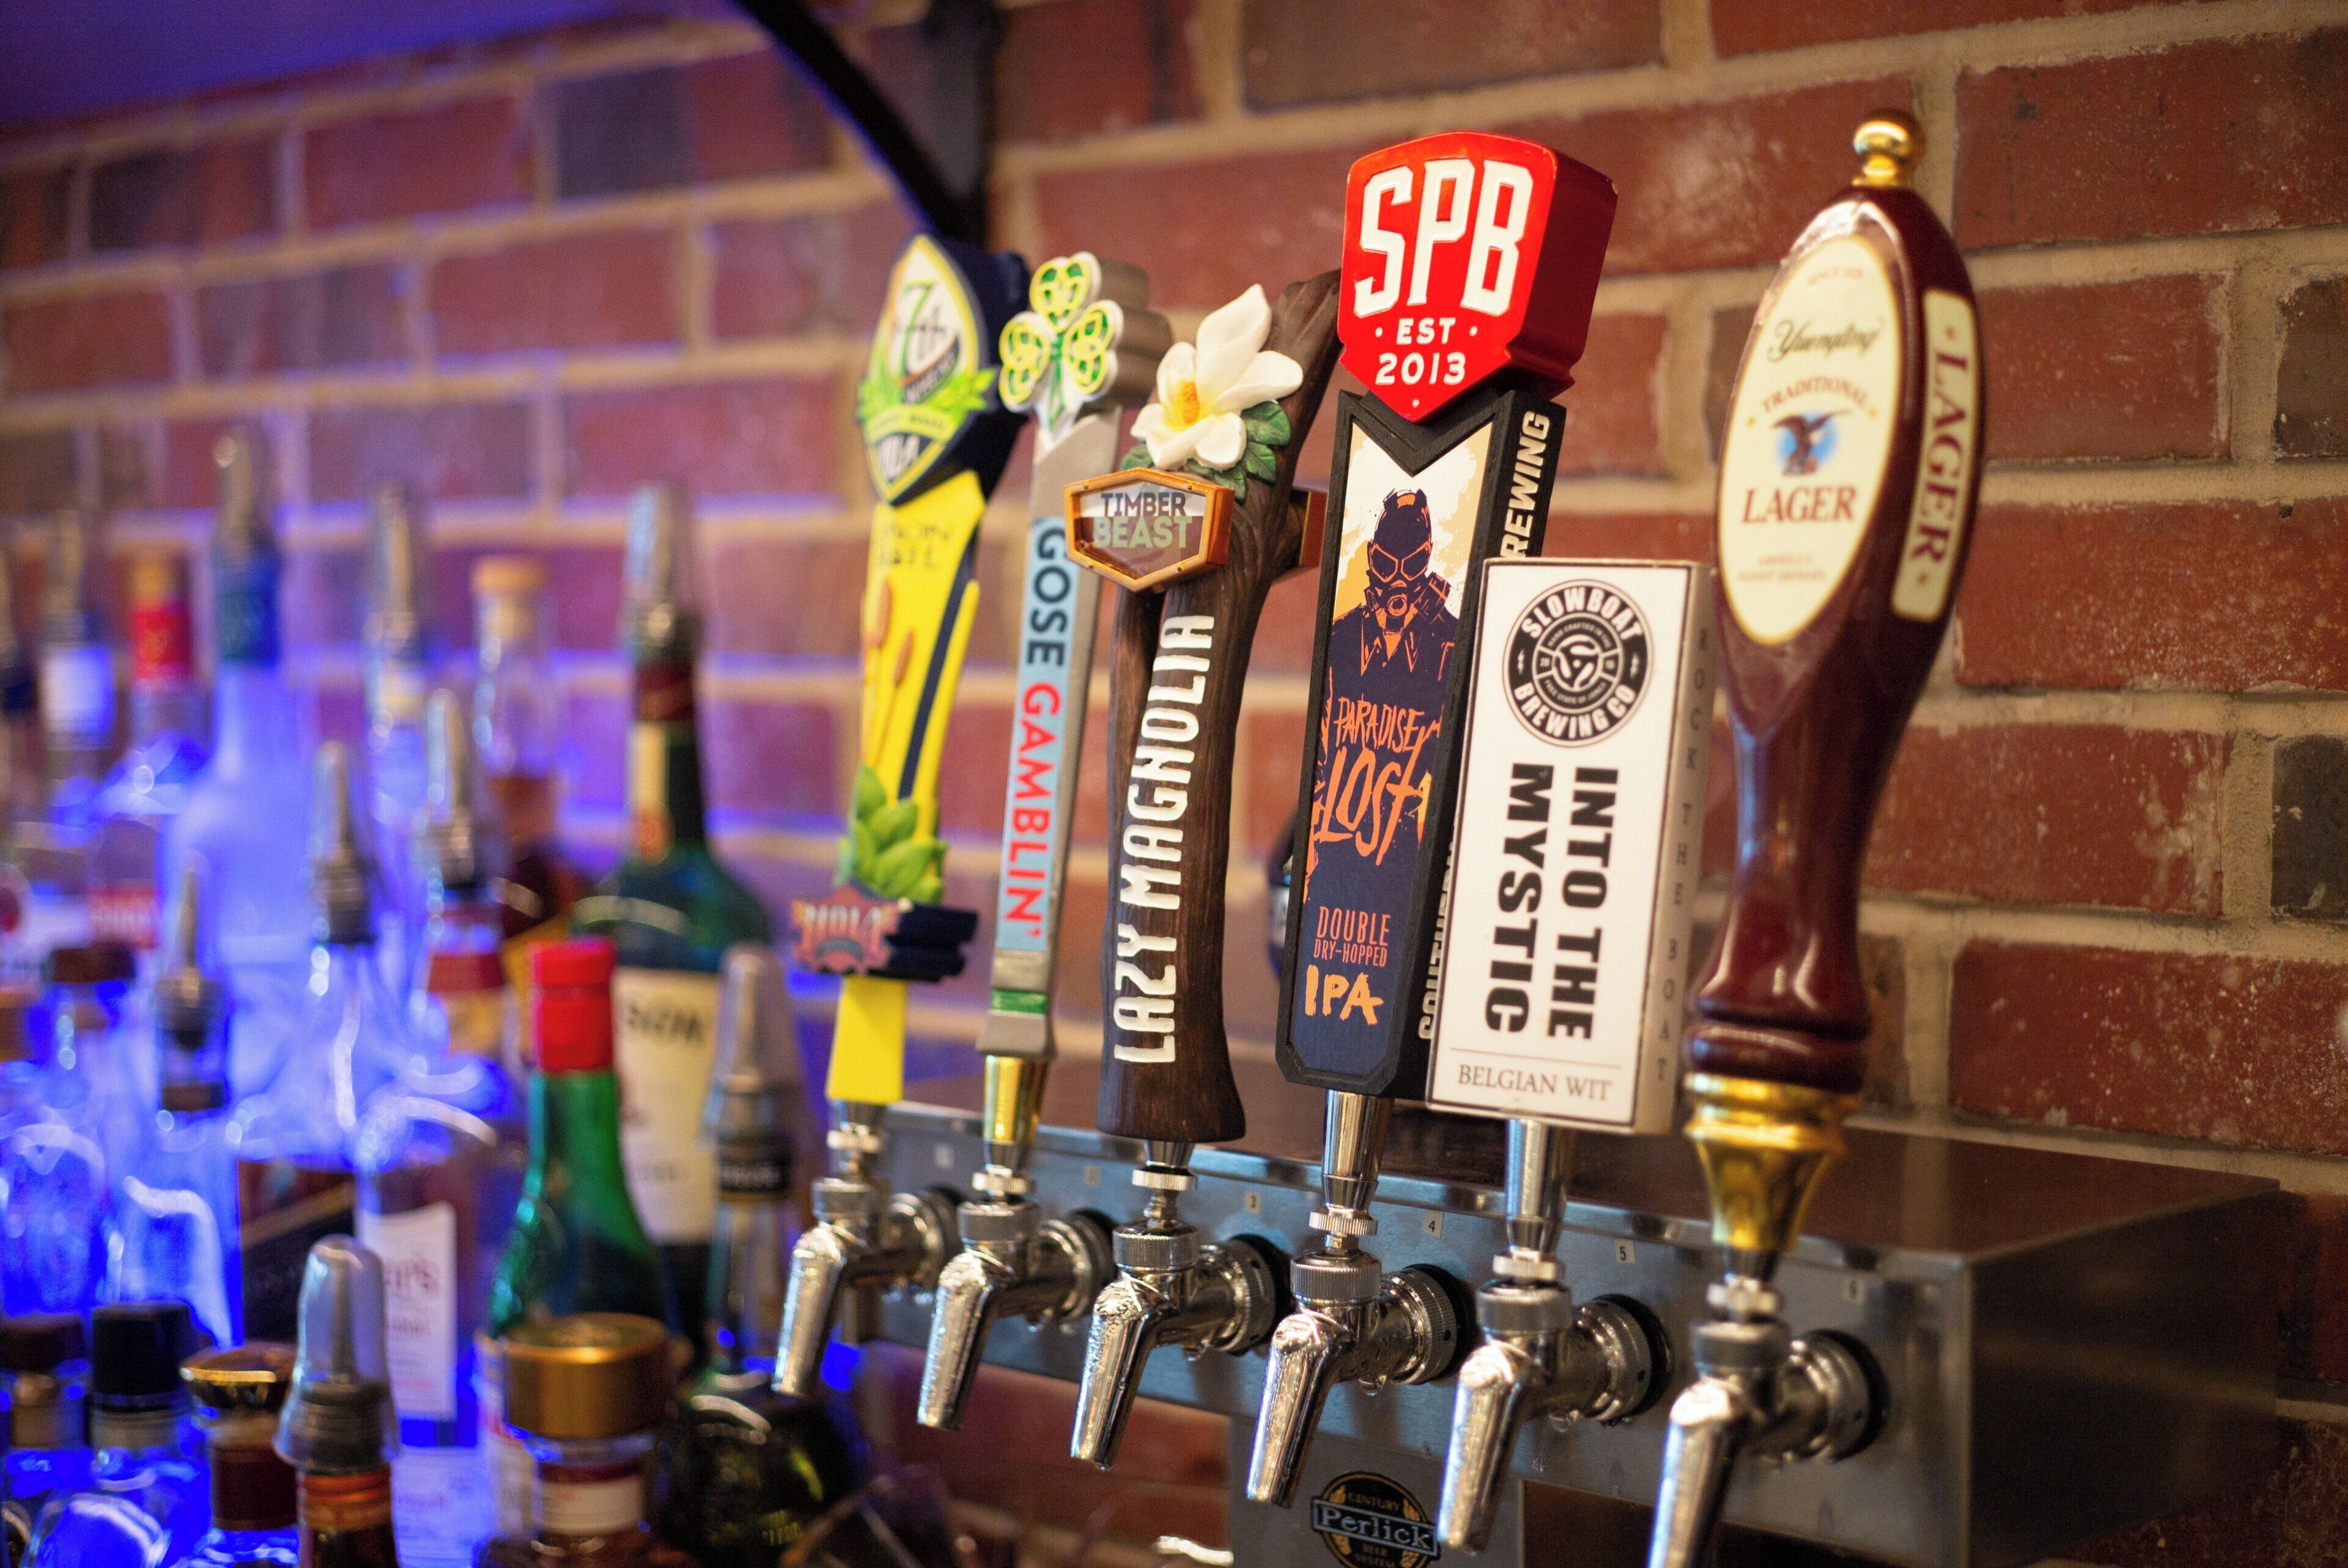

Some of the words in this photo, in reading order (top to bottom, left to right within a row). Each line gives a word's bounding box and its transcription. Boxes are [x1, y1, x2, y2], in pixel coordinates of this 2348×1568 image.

[1353, 158, 1534, 317] SPB
[1396, 317, 1456, 344] EST
[1375, 351, 1466, 385] 2013
[1762, 374, 1868, 412] TRADITIONAL
[1500, 411, 1550, 557] REWING
[1910, 350, 1968, 562] LAGER
[1093, 515, 1193, 549] BEAST
[1101, 492, 1186, 517] TIMBER
[1741, 485, 1857, 524] LAGER
[1026, 526, 1072, 668] GOSE
[1521, 586, 1643, 641] SLOWBOAT
[1333, 694, 1425, 754] PARADISE
[1513, 682, 1611, 740] BREWING
[1606, 683, 1637, 719] CO
[1120, 615, 1215, 910] MAGNOLIA
[1003, 681, 1062, 938] GAMBLIN'
[1315, 727, 1428, 866] LOST
[1561, 767, 1620, 910] INTO
[1316, 905, 1391, 946] DOUBLE
[1484, 762, 1555, 1034] MYSTIC
[1313, 938, 1388, 967] DRY-HOPPED
[1113, 922, 1177, 1063] LAZY
[1304, 964, 1384, 1026] IPA
[1547, 926, 1603, 1040] THE
[1457, 1064, 1557, 1094] BELGIAN
[1565, 1078, 1613, 1102] WIT
[1428, 1220, 1436, 1232] 4
[1620, 1245, 1626, 1261] 5
[1321, 1506, 1431, 1550] Perlick
